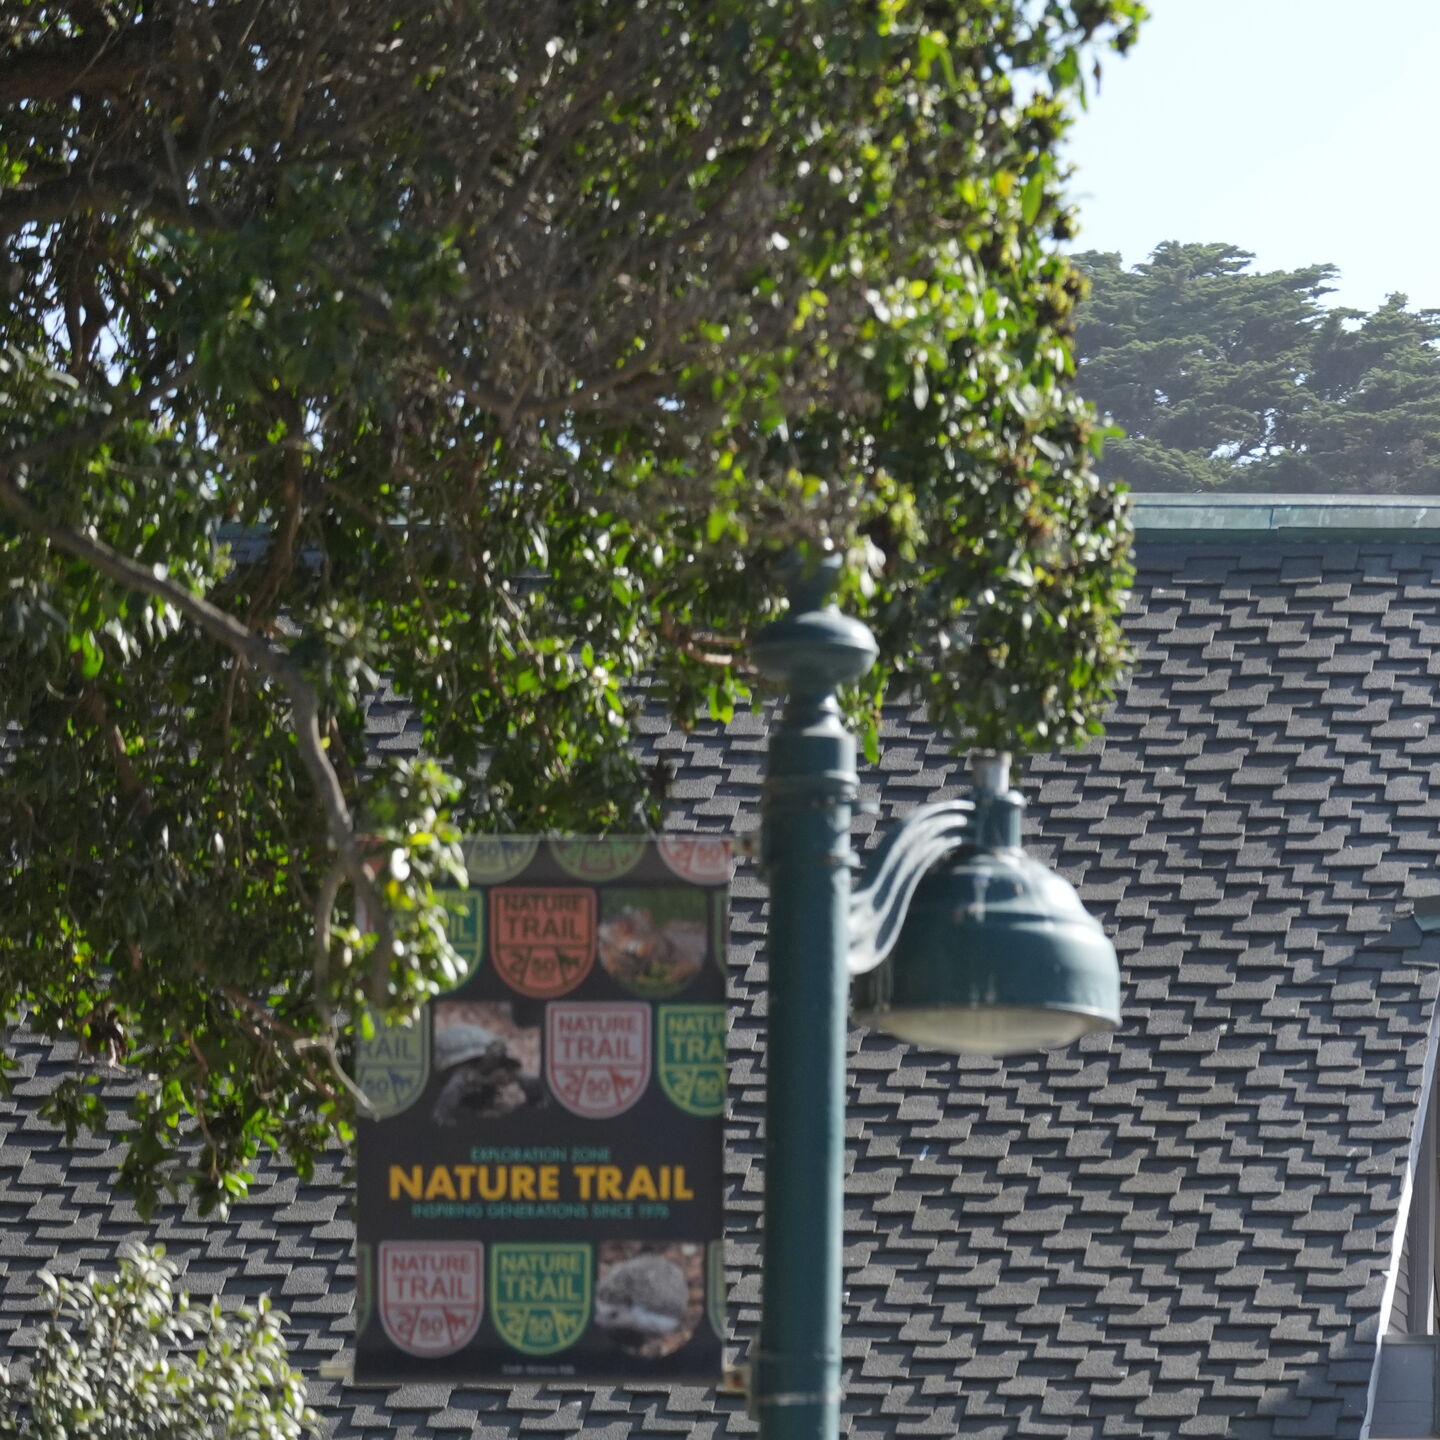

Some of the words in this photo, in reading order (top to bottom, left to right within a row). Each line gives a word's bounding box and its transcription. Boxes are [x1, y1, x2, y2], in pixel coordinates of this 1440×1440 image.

[503, 893, 582, 912] NATURE
[505, 917, 582, 940] TRAIL
[558, 1015, 635, 1033] NATURE
[561, 1036, 636, 1059] TRAIL
[470, 1146, 567, 1162] EXPLORATION
[571, 1146, 611, 1162] ZONE
[389, 1164, 560, 1200] NATURE
[573, 1164, 694, 1200] TRAIL
[411, 1203, 484, 1219] INSPIRING
[486, 1203, 589, 1219] GENERATIONS
[591, 1203, 635, 1219] SINCE
[391, 1254, 469, 1273] NATURE
[502, 1254, 579, 1273] NATURE
[393, 1276, 470, 1300] TRAIL
[504, 1276, 580, 1300] TRAIL
